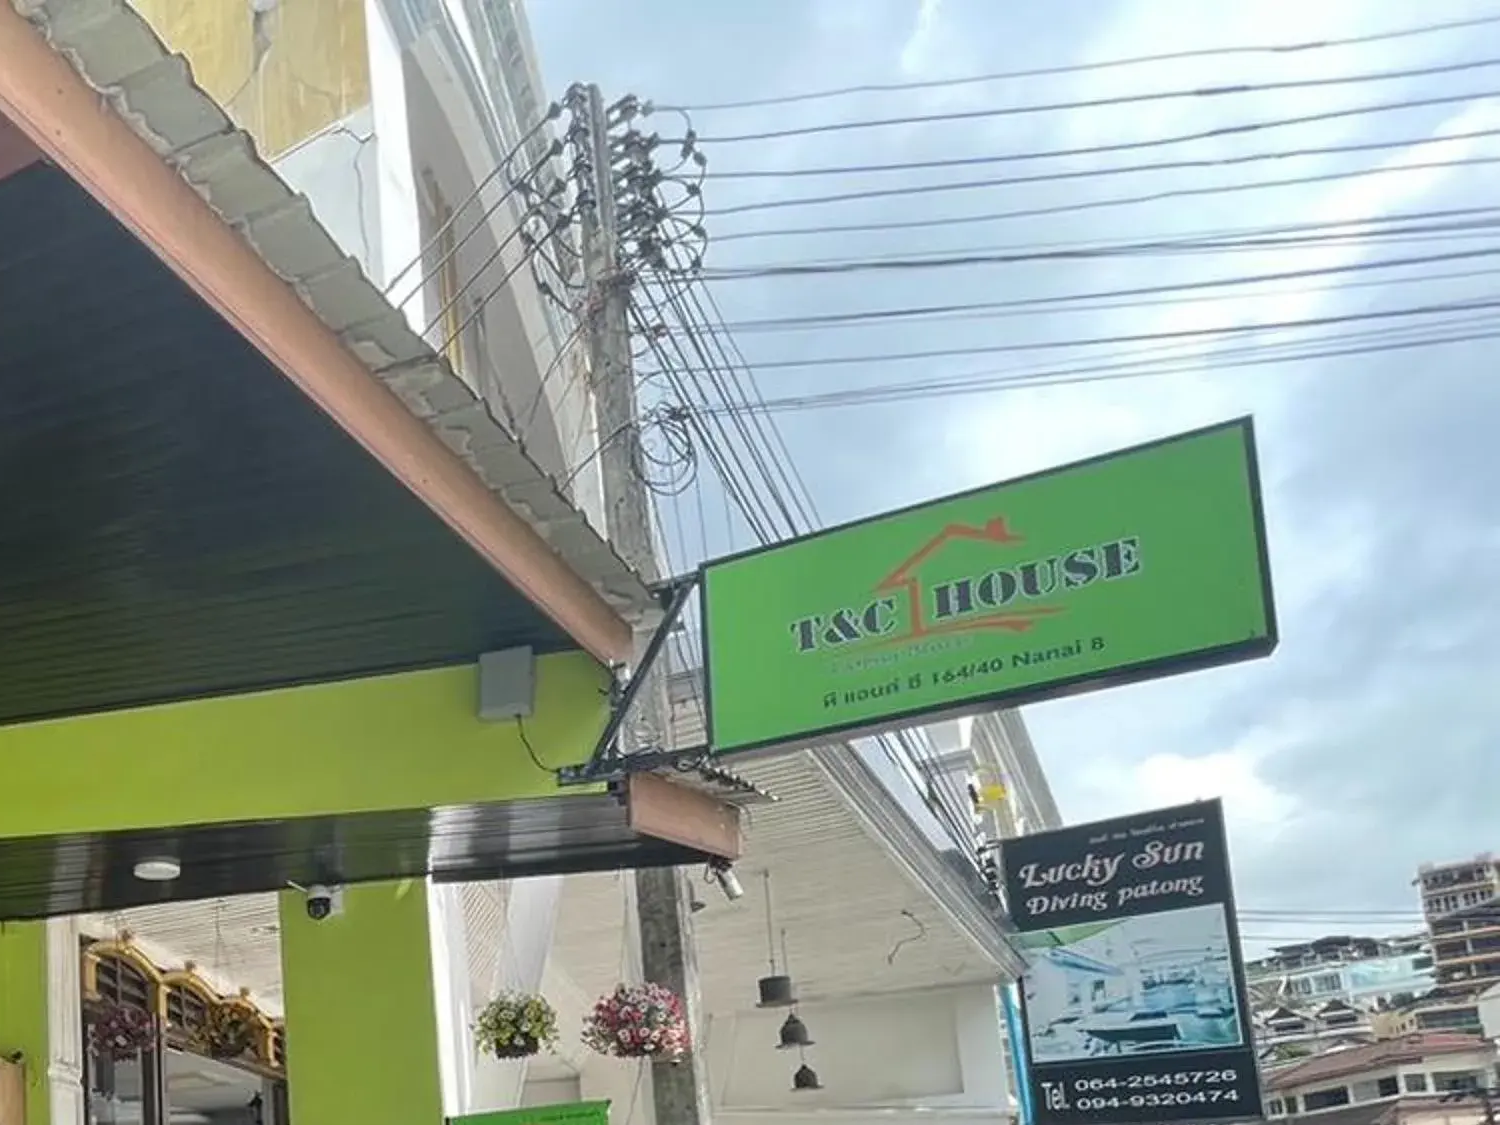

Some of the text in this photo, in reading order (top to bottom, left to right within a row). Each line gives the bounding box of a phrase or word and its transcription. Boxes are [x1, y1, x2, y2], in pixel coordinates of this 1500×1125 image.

[790, 538, 1141, 652] T&C HOUSE
[932, 657, 1002, 685] 164/40
[1012, 639, 1082, 668] Nanai
[1091, 636, 1105, 651] 8
[1018, 840, 1204, 888] Lucky Sun
[1026, 875, 1204, 915] Diving patong
